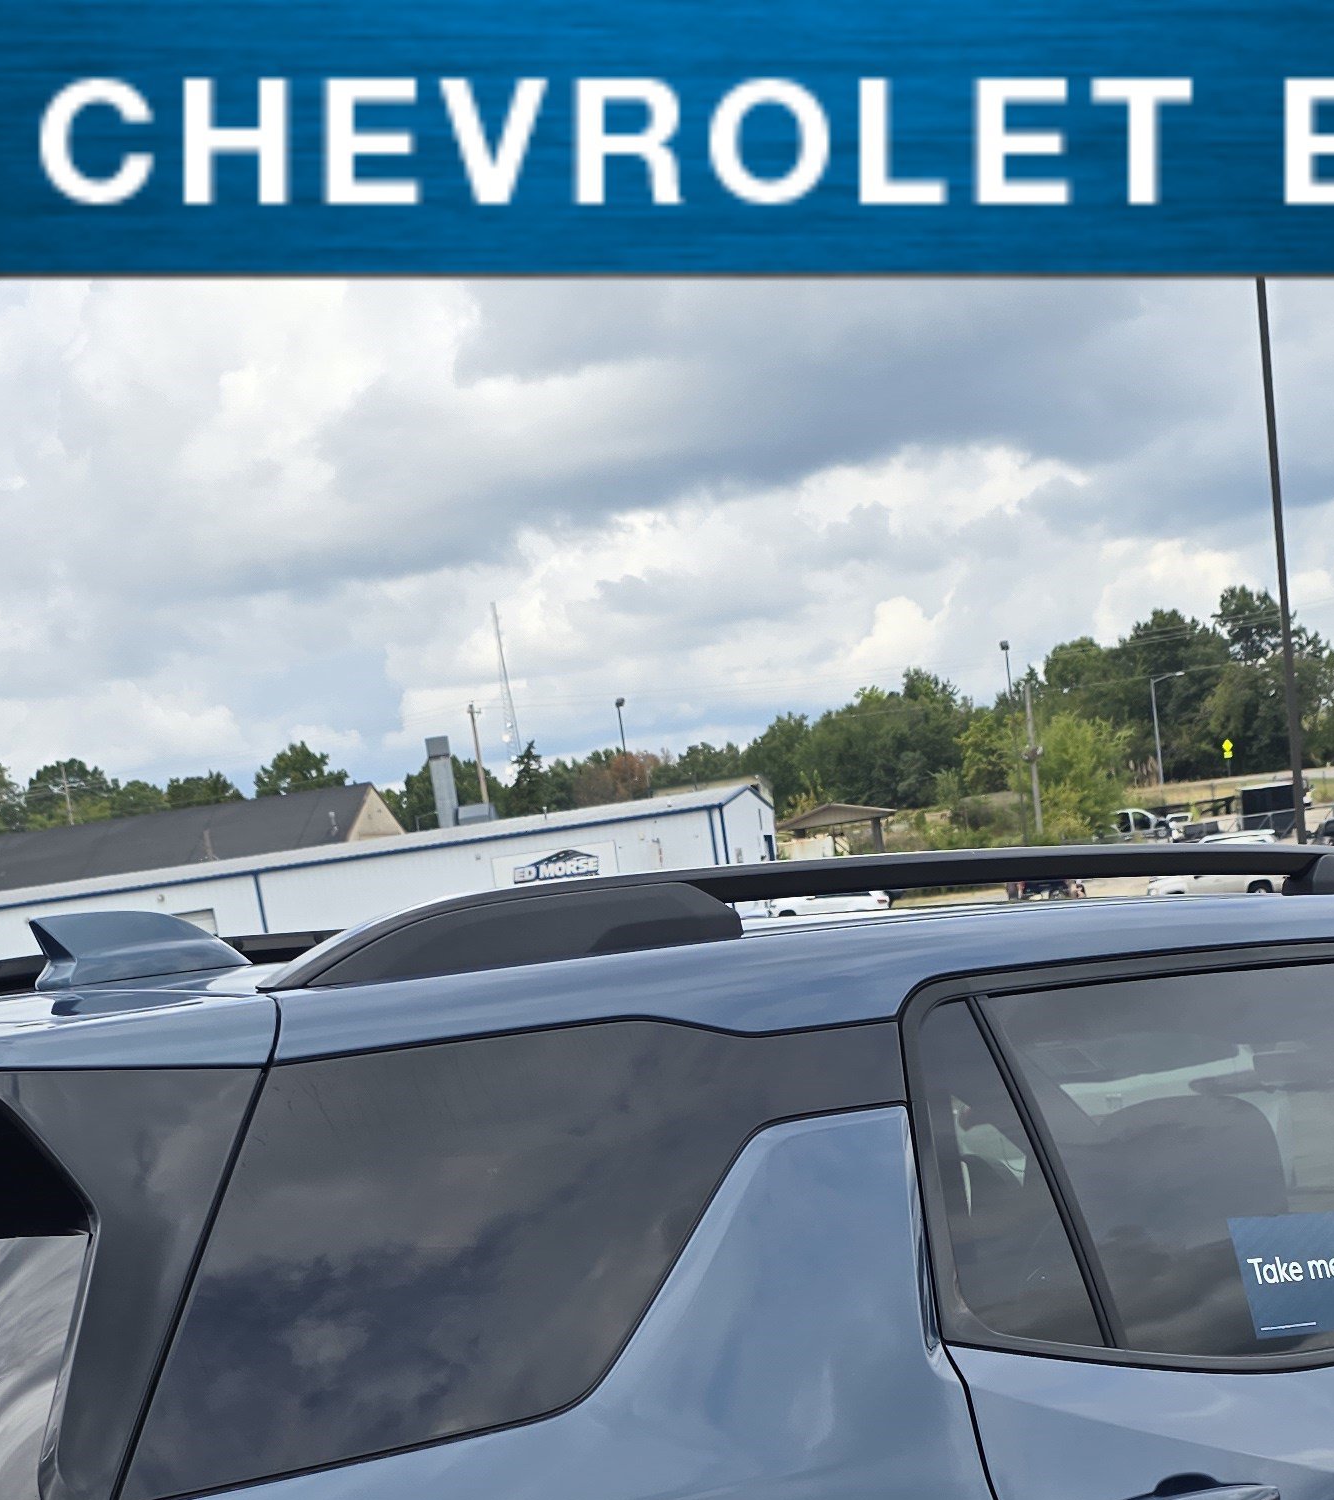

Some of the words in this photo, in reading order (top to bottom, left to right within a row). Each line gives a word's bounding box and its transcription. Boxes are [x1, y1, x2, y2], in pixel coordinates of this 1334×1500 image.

[514, 866, 537, 883] ED
[538, 856, 599, 879] MORSE
[1246, 1255, 1304, 1285] Take
